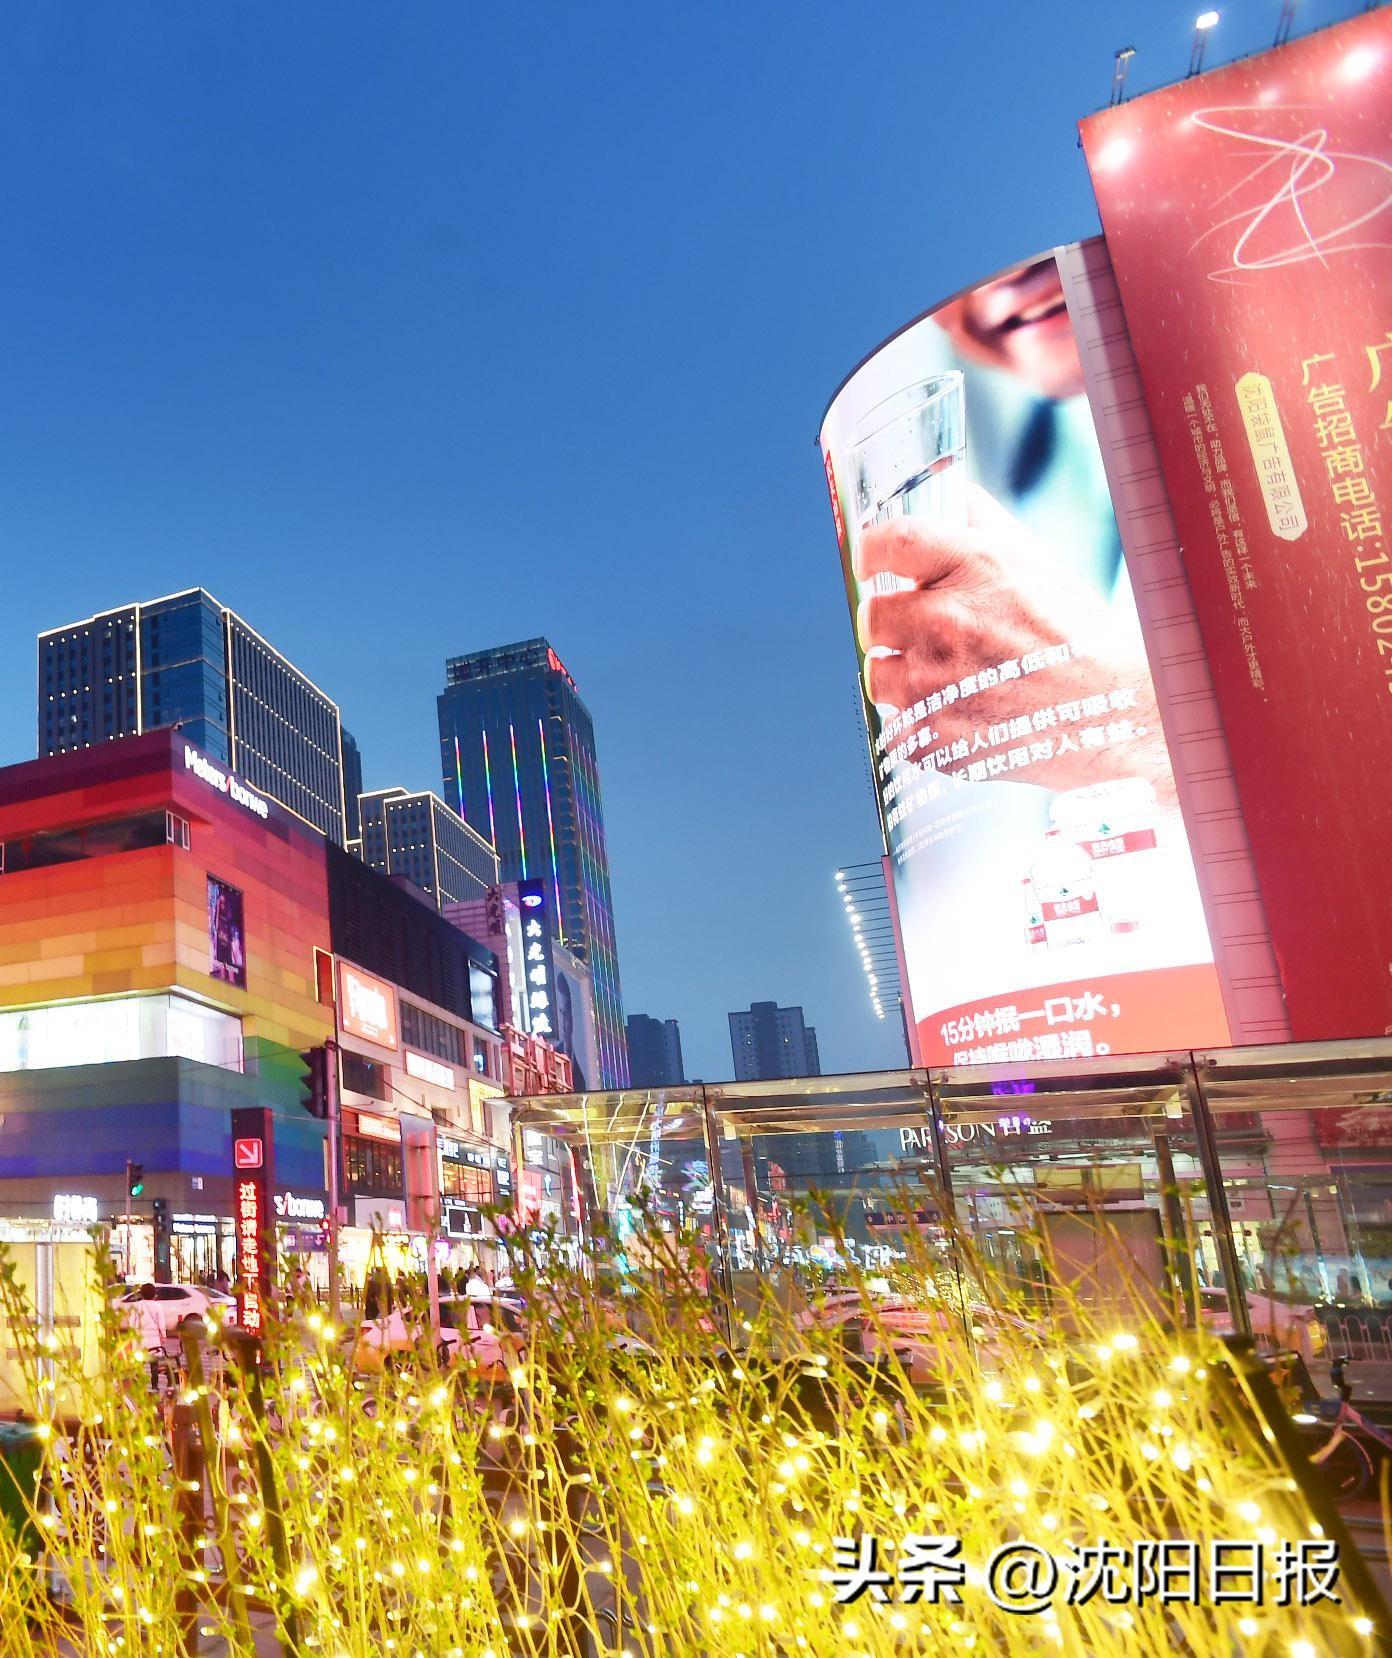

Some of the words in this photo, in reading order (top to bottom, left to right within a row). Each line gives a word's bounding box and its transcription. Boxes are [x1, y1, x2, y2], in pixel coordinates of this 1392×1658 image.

[899, 1122, 996, 1151] PARSON
[239, 1181, 261, 1336] 过街请走地下自动
